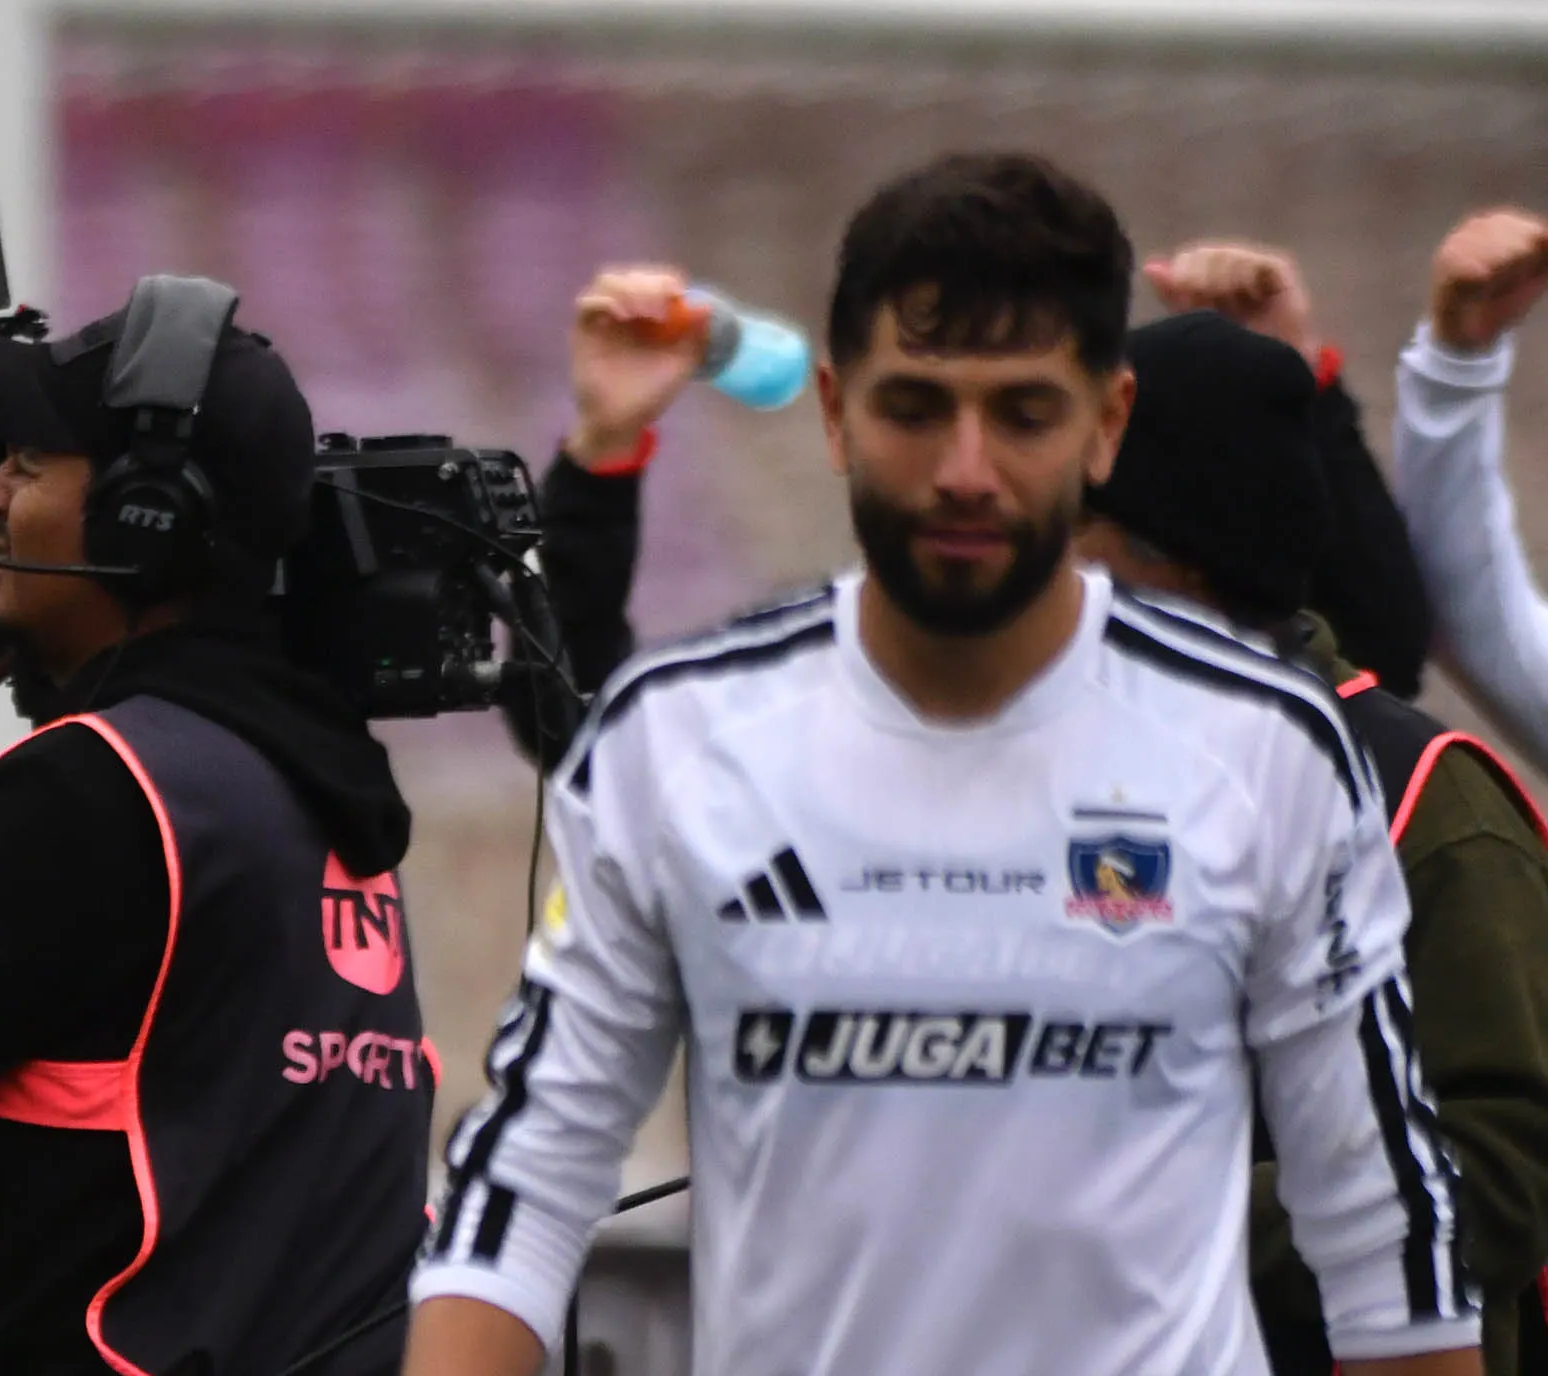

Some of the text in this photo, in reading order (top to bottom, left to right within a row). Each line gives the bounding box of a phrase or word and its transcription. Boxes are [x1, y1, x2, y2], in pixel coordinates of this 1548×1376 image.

[119, 505, 174, 532] RTS
[840, 868, 1046, 895] JETOUR
[282, 1029, 423, 1090] SPORT
